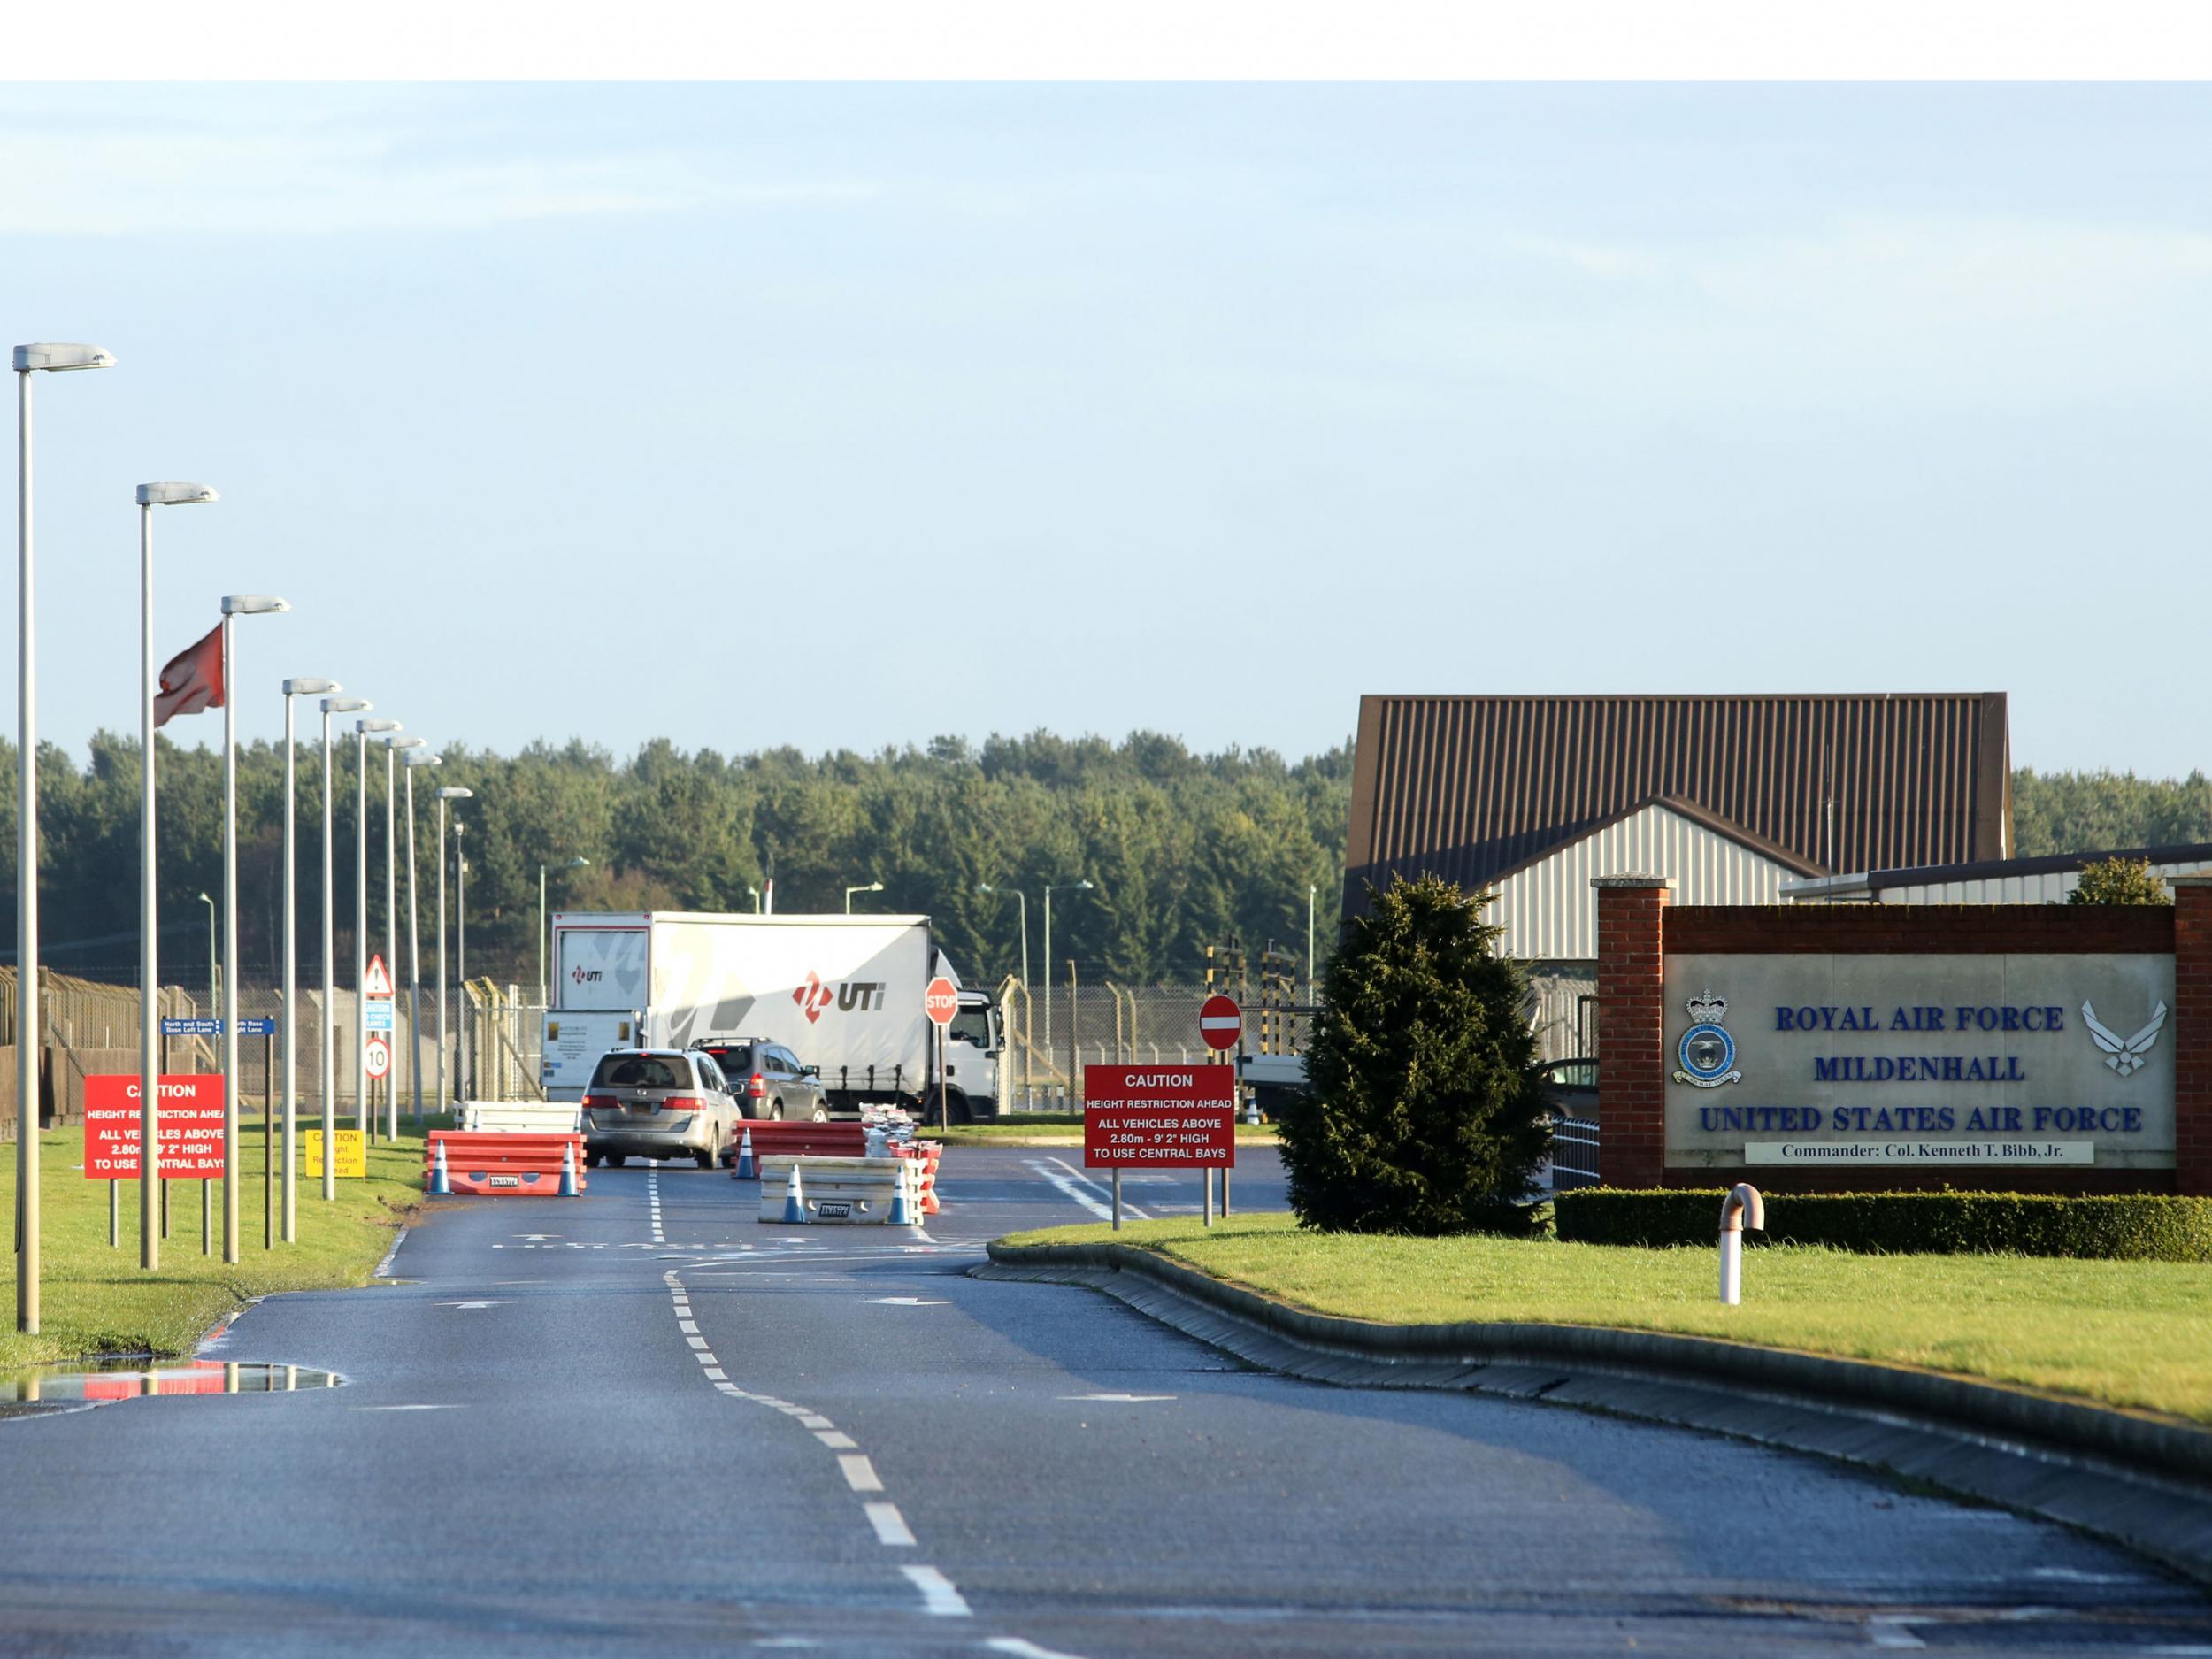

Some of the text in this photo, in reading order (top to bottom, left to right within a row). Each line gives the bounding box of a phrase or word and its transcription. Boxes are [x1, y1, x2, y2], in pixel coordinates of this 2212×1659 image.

[586, 971, 602, 982] UTi
[837, 983, 886, 1012] UTi
[927, 995, 955, 1008] STOP
[1775, 1007, 2063, 1031] ROYAL AIR FORCE
[369, 1051, 384, 1066] 10
[1814, 1056, 2024, 1081] MILDENHALL
[1125, 1074, 1193, 1087] CAUTION
[127, 1085, 196, 1097] CTION
[1087, 1100, 1231, 1109] HEIGHT RESTRICTION AHEAD
[88, 1110, 126, 1119] HEIGHT
[1700, 1107, 2141, 1131] UNITED STATES AIR FORCE
[1098, 1118, 1221, 1129] ALL VEHICLES ABOVE
[99, 1130, 121, 1139] ALL
[124, 1129, 181, 1140] VELES
[313, 1133, 357, 1142] CTION
[1110, 1134, 1144, 1144] 2.80m
[1154, 1134, 1163, 1144] 9'
[1166, 1134, 1177, 1144] 2"
[1180, 1134, 1209, 1144] HIGH
[182, 1144, 212, 1153] HIGH
[1094, 1148, 1226, 1158] TO USE CENTRAL BAYS
[1782, 1144, 2063, 1158] Commander: Col. Kenneth T. Bibb, Jr.
[94, 1159, 224, 1169] TO USE NTRAL BAY
